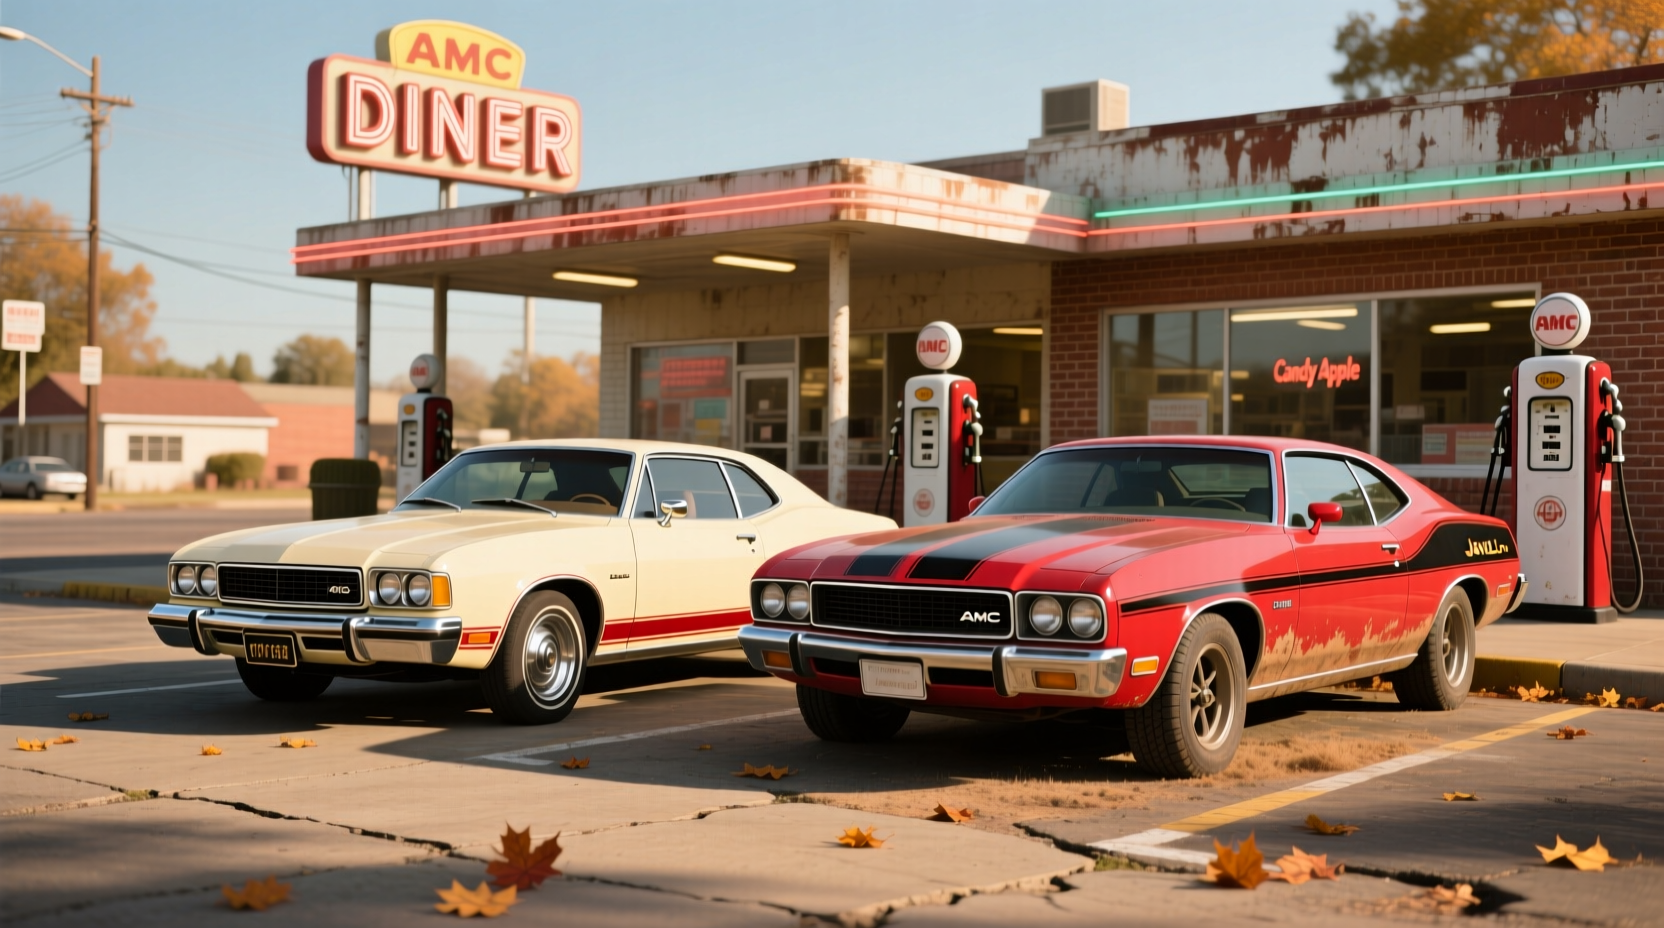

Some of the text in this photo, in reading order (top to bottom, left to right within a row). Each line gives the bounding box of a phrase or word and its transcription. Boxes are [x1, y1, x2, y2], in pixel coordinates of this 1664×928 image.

[406, 32, 512, 80] AMC
[336, 71, 573, 179] DINER
[1535, 314, 1578, 331] AMC
[1273, 355, 1361, 388] Candy Apple
[960, 611, 1001, 623] AMC
